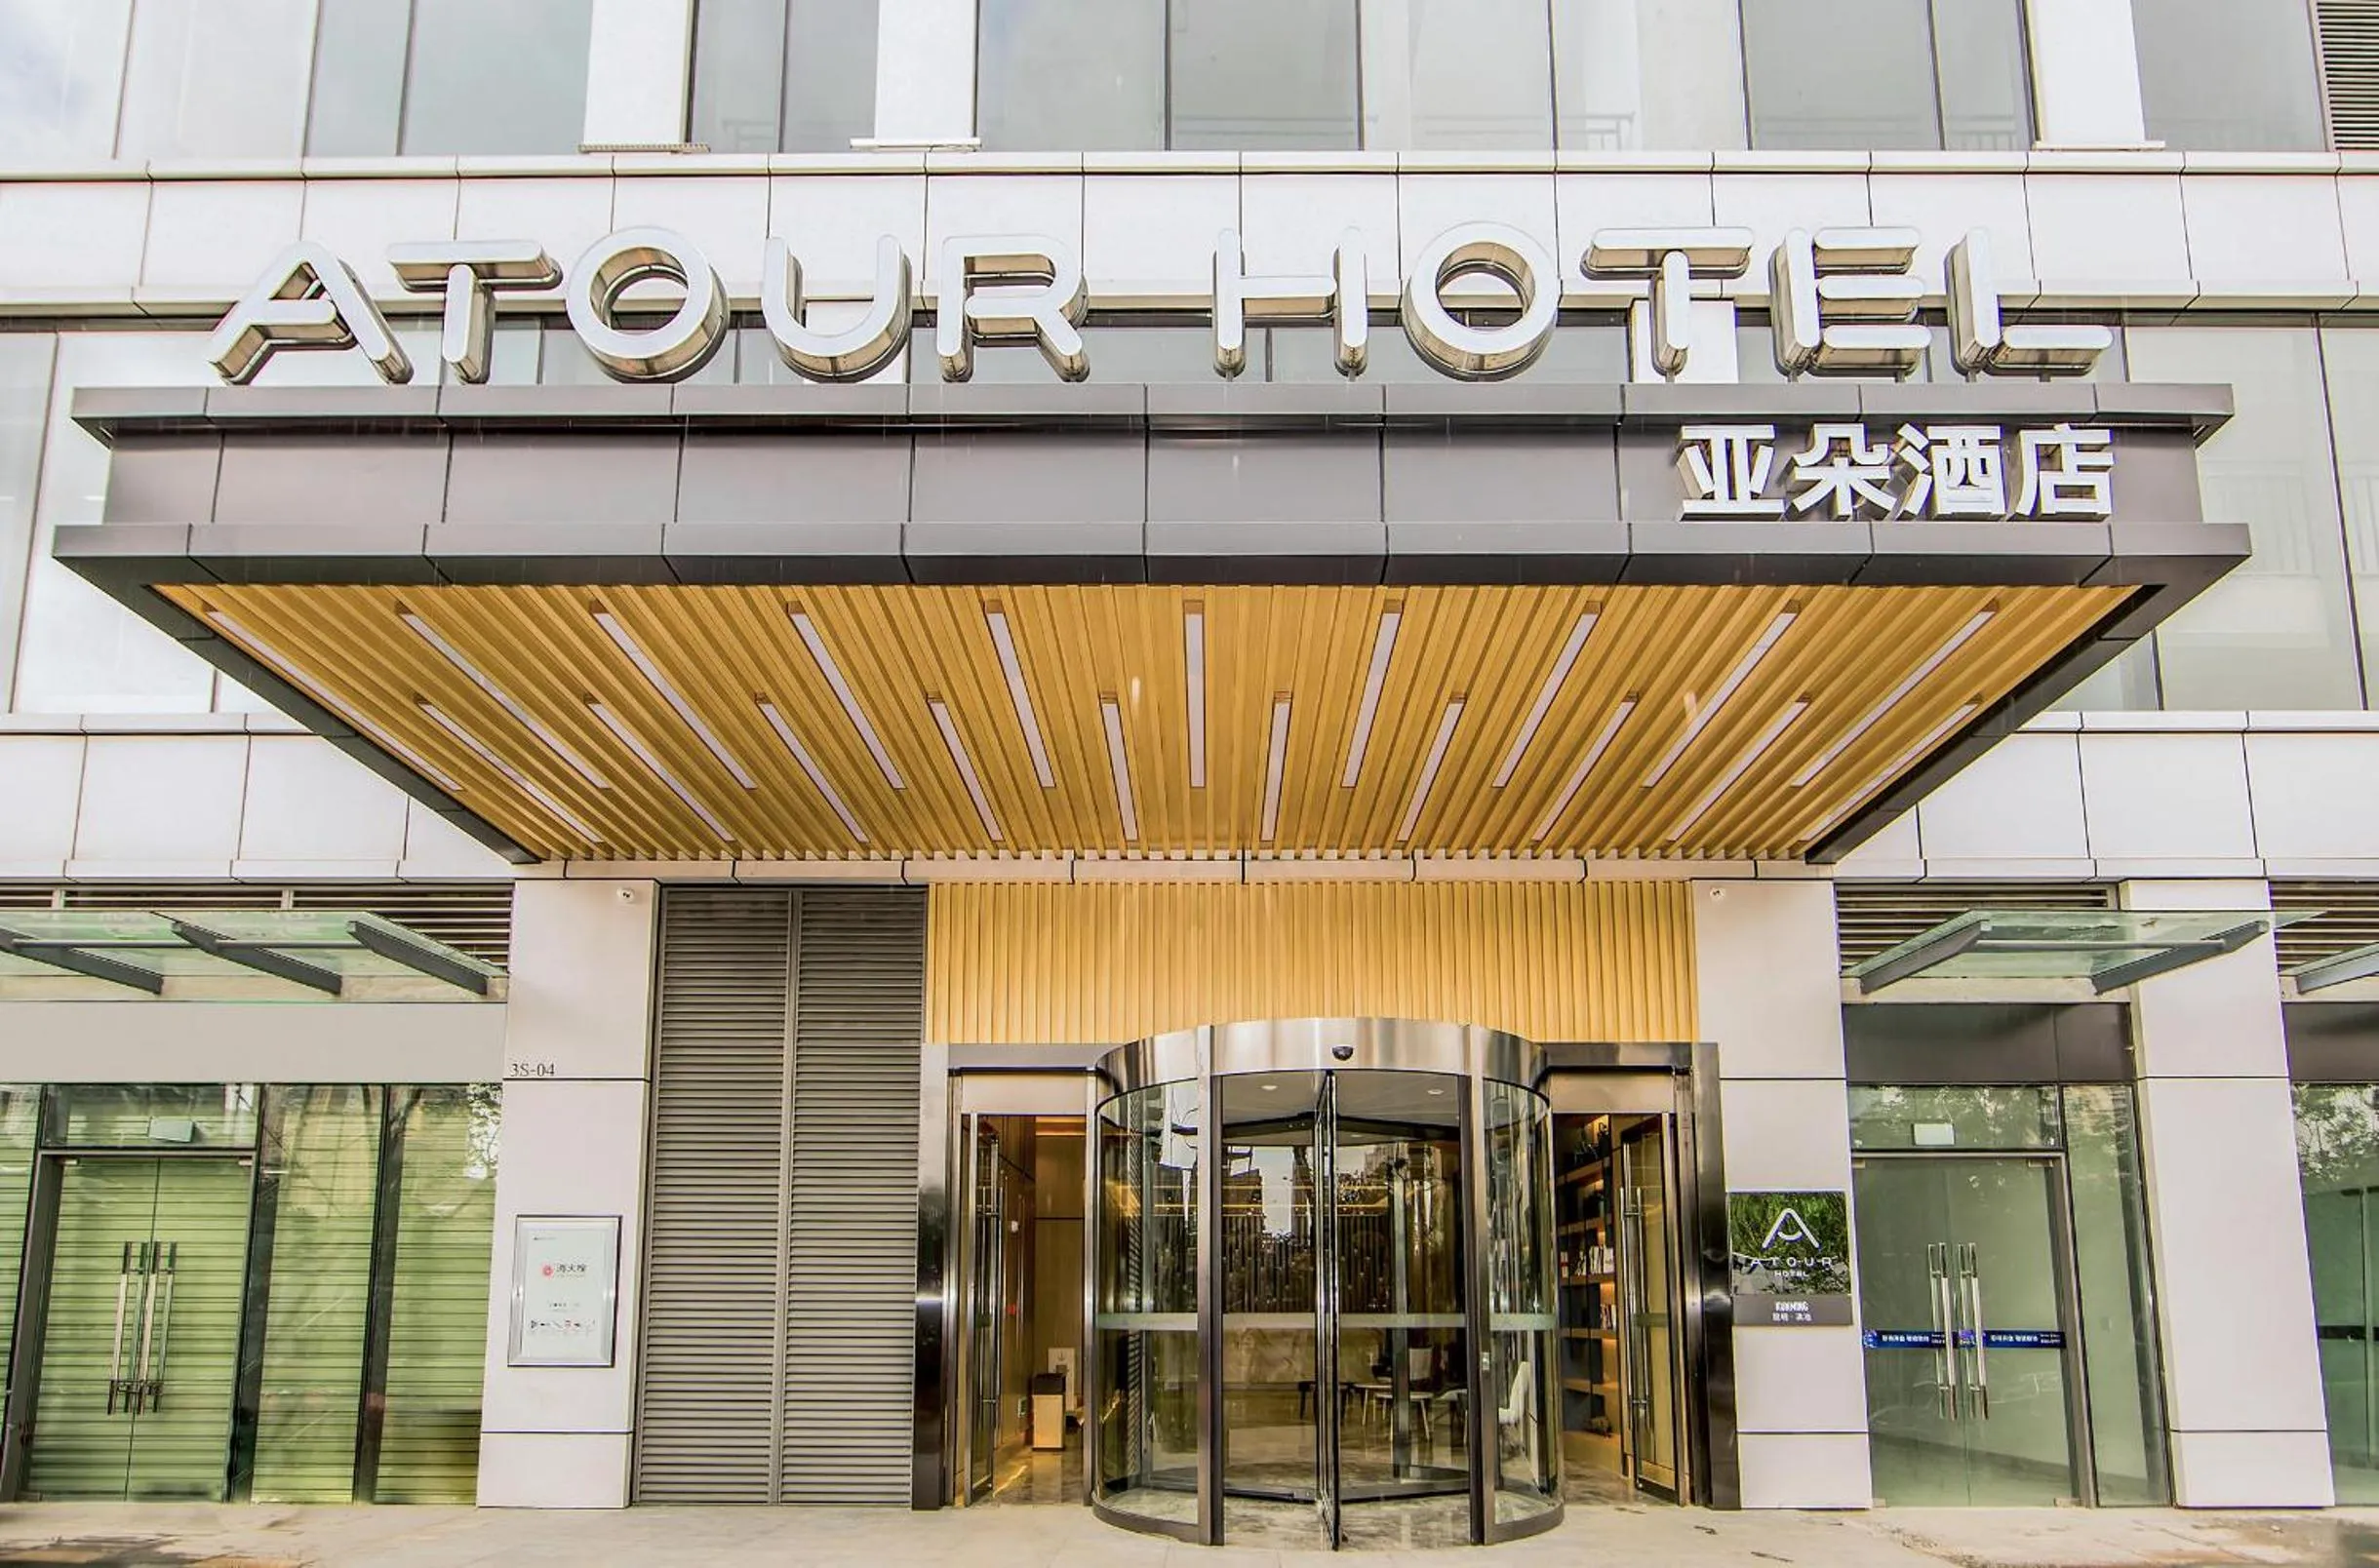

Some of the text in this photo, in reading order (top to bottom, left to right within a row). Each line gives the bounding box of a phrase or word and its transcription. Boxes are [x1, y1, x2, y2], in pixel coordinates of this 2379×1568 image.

[208, 221, 2115, 384] ATOUR HOTEL
[1678, 422, 2115, 522] 亚朵酒店
[510, 1063, 555, 1077] 3S-04
[1749, 1257, 1834, 1269] ATOUR
